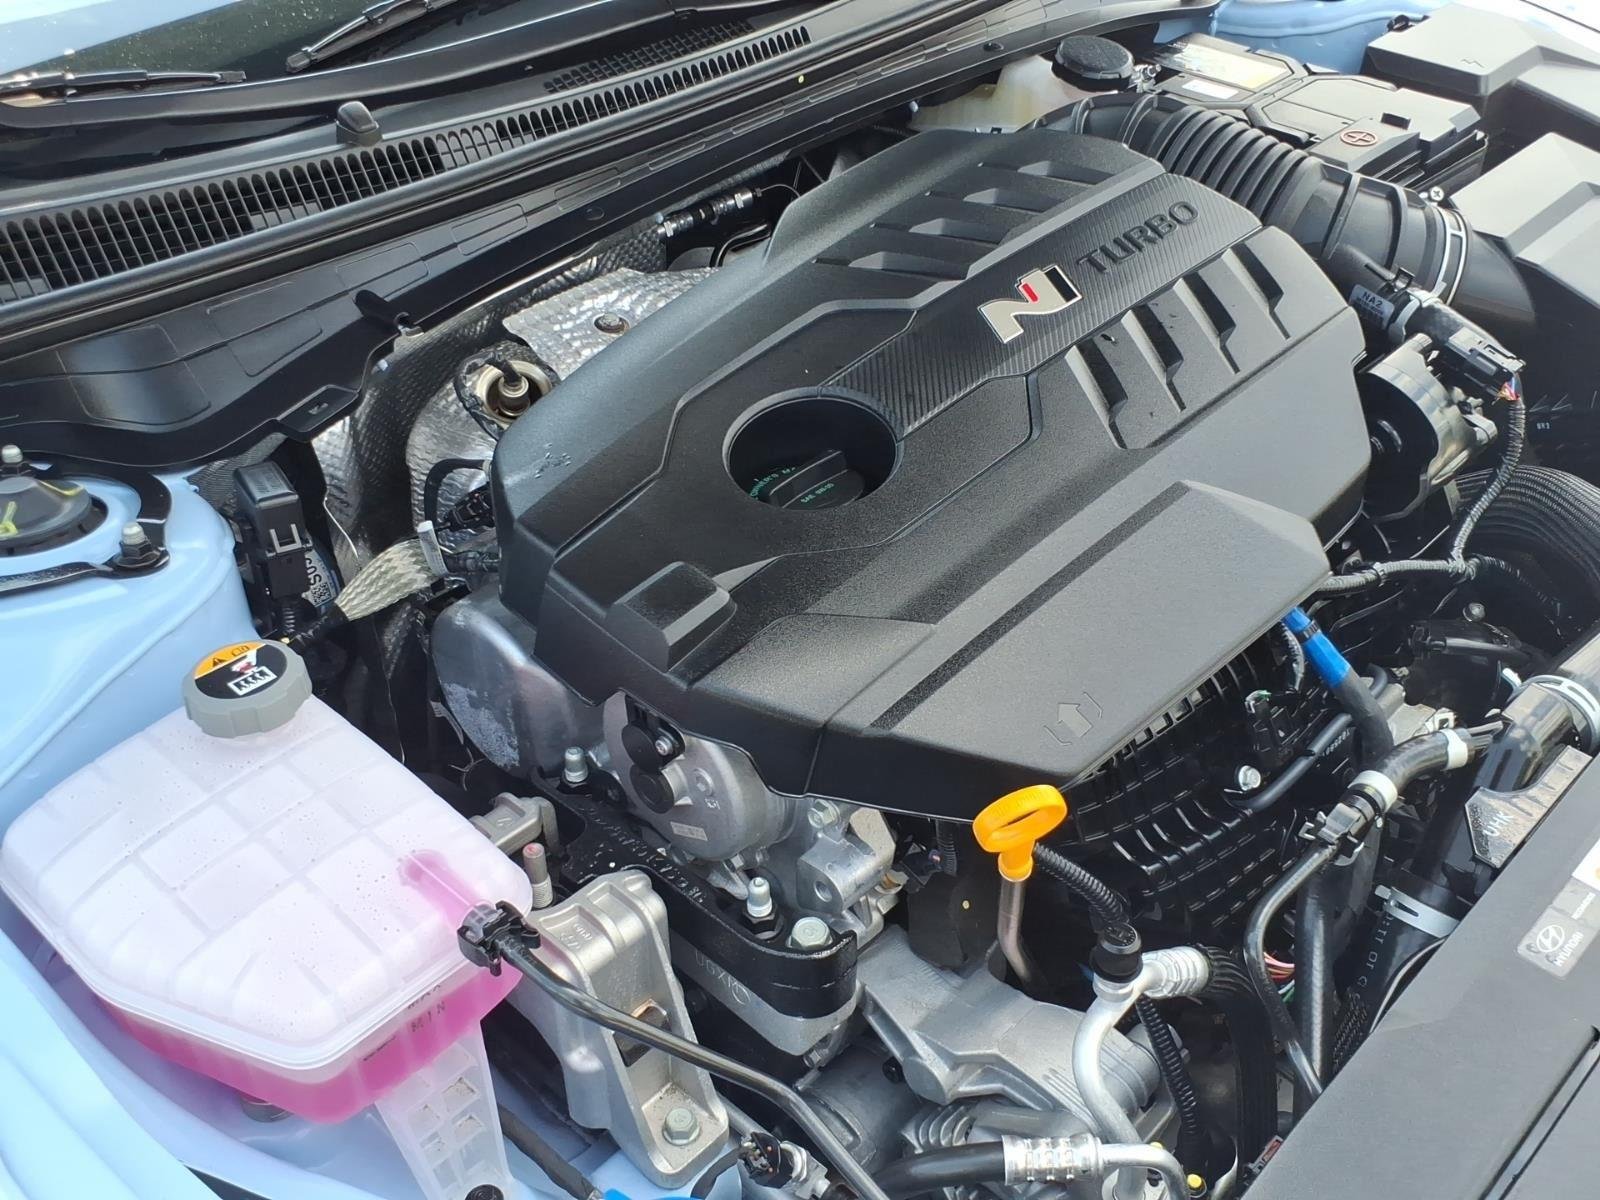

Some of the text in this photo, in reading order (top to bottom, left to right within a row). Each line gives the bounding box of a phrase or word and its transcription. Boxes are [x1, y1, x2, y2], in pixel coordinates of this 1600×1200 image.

[1076, 201, 1200, 273] TURBO
[1362, 291, 1383, 308] NA2
[1483, 811, 1515, 837] UHK
[1554, 931, 1584, 968] HYUNDAI
[411, 1001, 446, 1033] MIN
